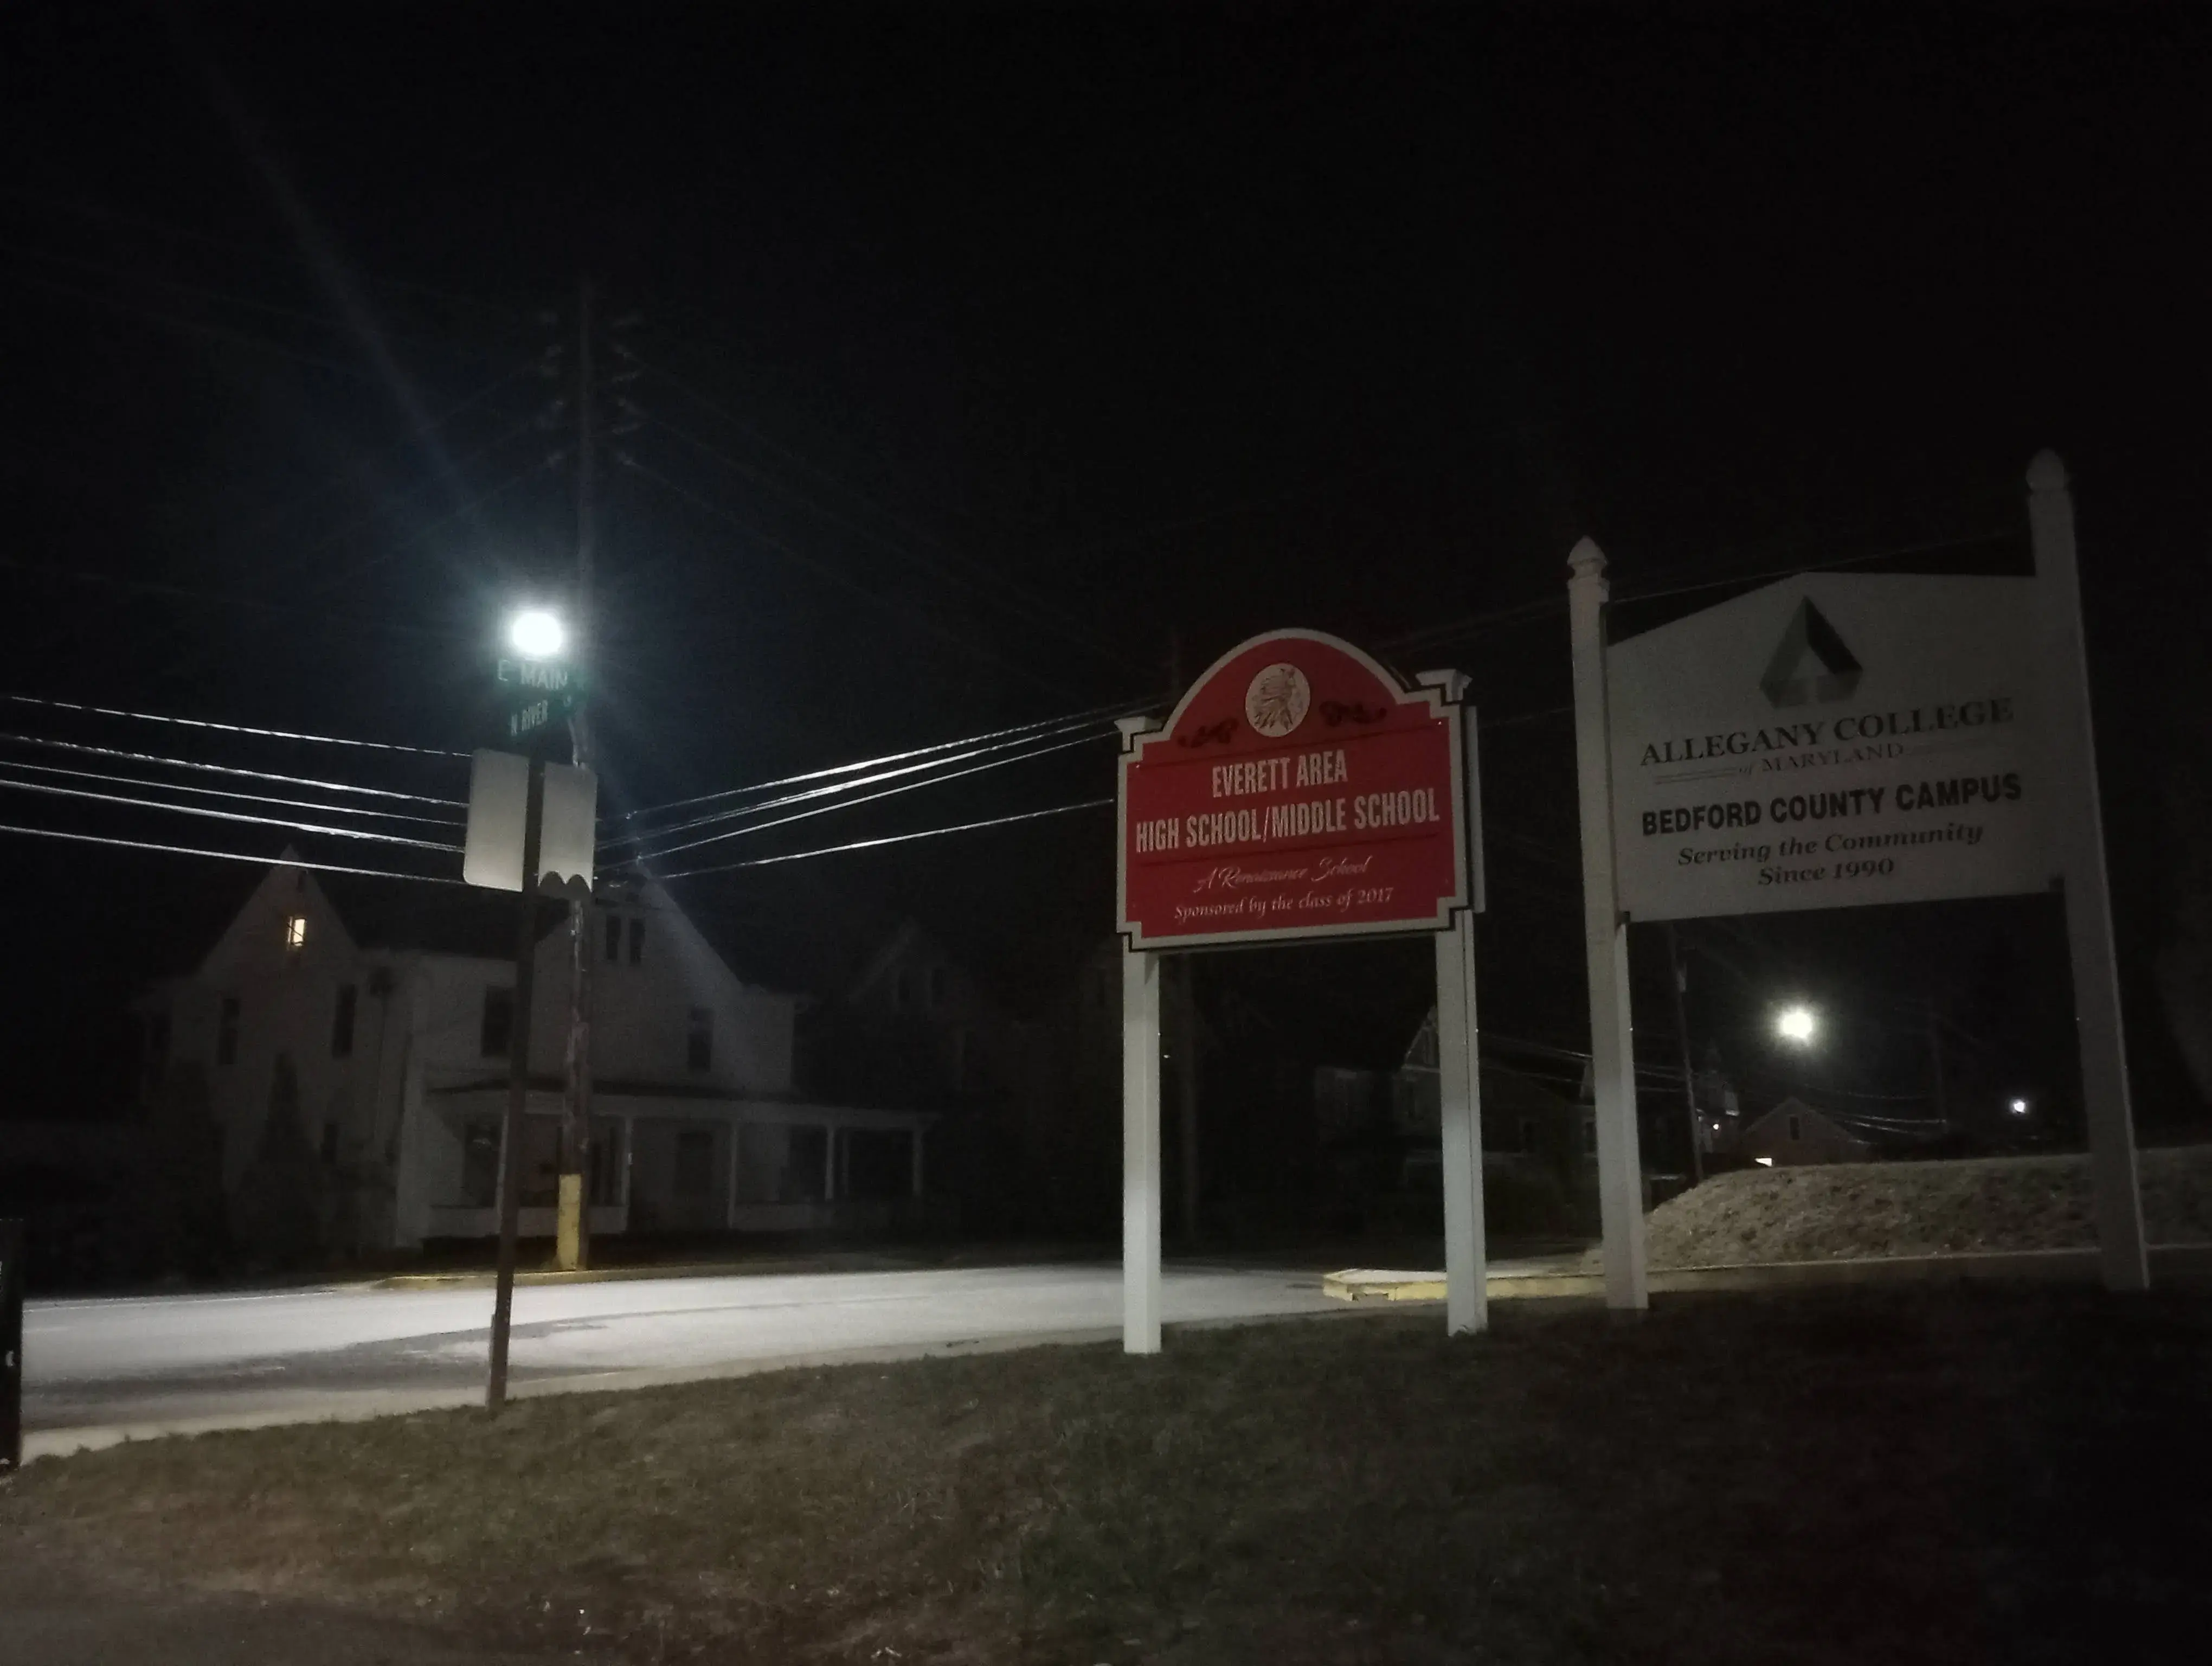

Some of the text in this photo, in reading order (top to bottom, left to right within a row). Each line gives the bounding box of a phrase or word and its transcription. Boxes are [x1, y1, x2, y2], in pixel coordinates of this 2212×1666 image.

[1639, 697, 2015, 766] ALLEGANY COLLEGE
[1211, 749, 1348, 799] EVERETT AREA
[1739, 742, 1904, 776] of MARYLAND
[1136, 787, 1441, 853] HIGH SCHOOL/MIDDLE SCHOOL
[1642, 773, 2022, 836] BEDFORD COUNTY CAMPUS
[1678, 822, 1984, 866] Serving the Community
[1193, 867, 1216, 894] A
[1310, 854, 1373, 882] School
[1758, 858, 1895, 886] Since 1990
[1174, 886, 1394, 925] Sponsored by the class of 2017
